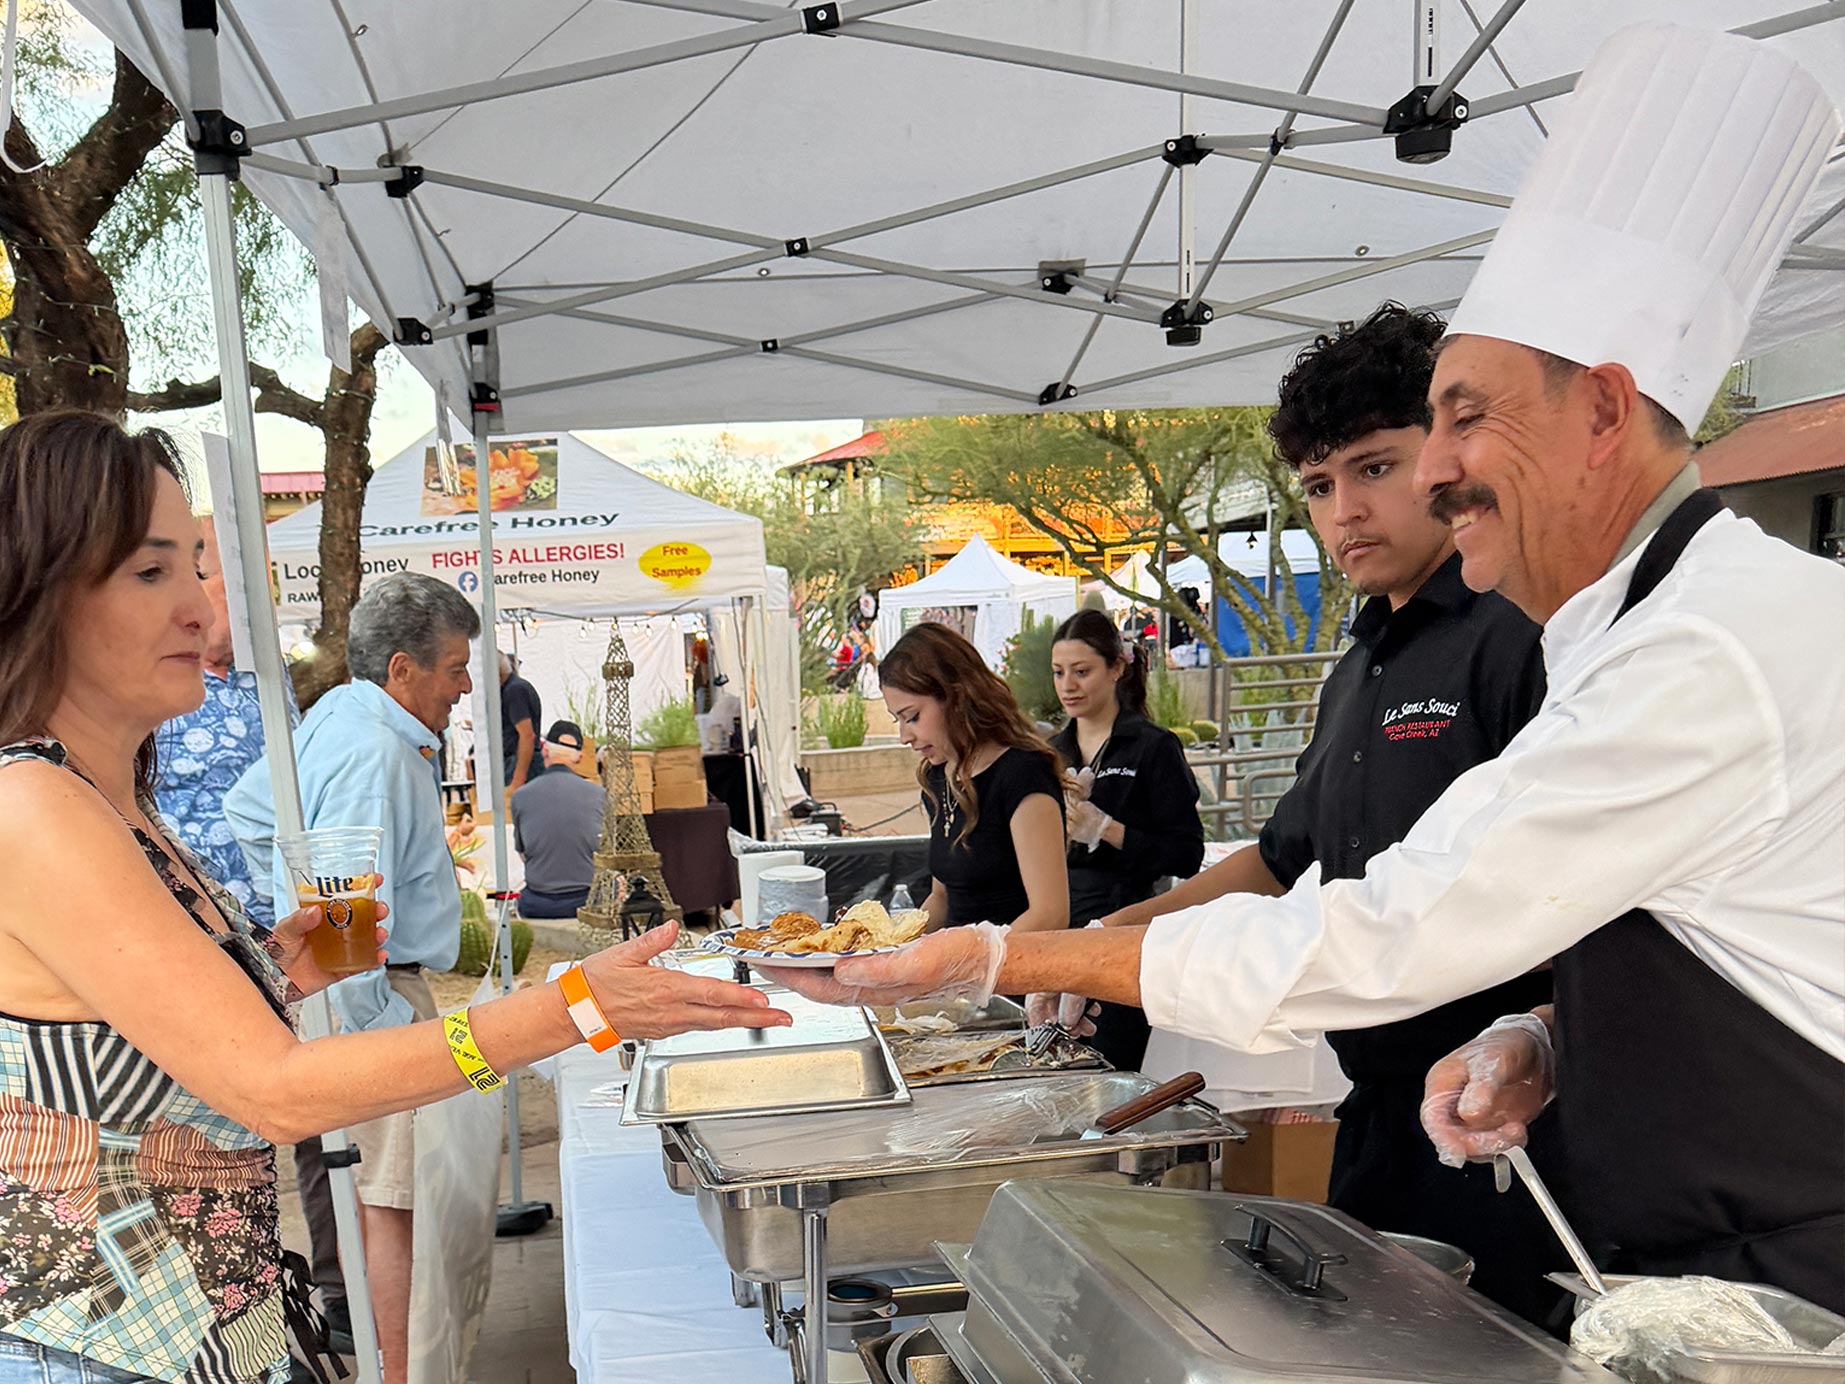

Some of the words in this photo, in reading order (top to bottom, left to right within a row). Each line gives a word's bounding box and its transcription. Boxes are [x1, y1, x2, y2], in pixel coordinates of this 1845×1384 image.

[511, 513, 620, 529] Honey
[431, 549, 503, 568] FIGHS
[508, 543, 625, 564] ALLERGIES!
[662, 546, 688, 556] Free
[284, 562, 322, 579] Loc
[361, 557, 409, 575] oney
[494, 571, 547, 585] arefree
[551, 569, 600, 585] Honey
[652, 565, 702, 579] Samples
[1381, 708, 1398, 726] Le
[1398, 702, 1425, 719] Sans
[1424, 698, 1461, 717] Souci
[315, 876, 354, 898] Lite
[468, 1066, 501, 1091] 21
